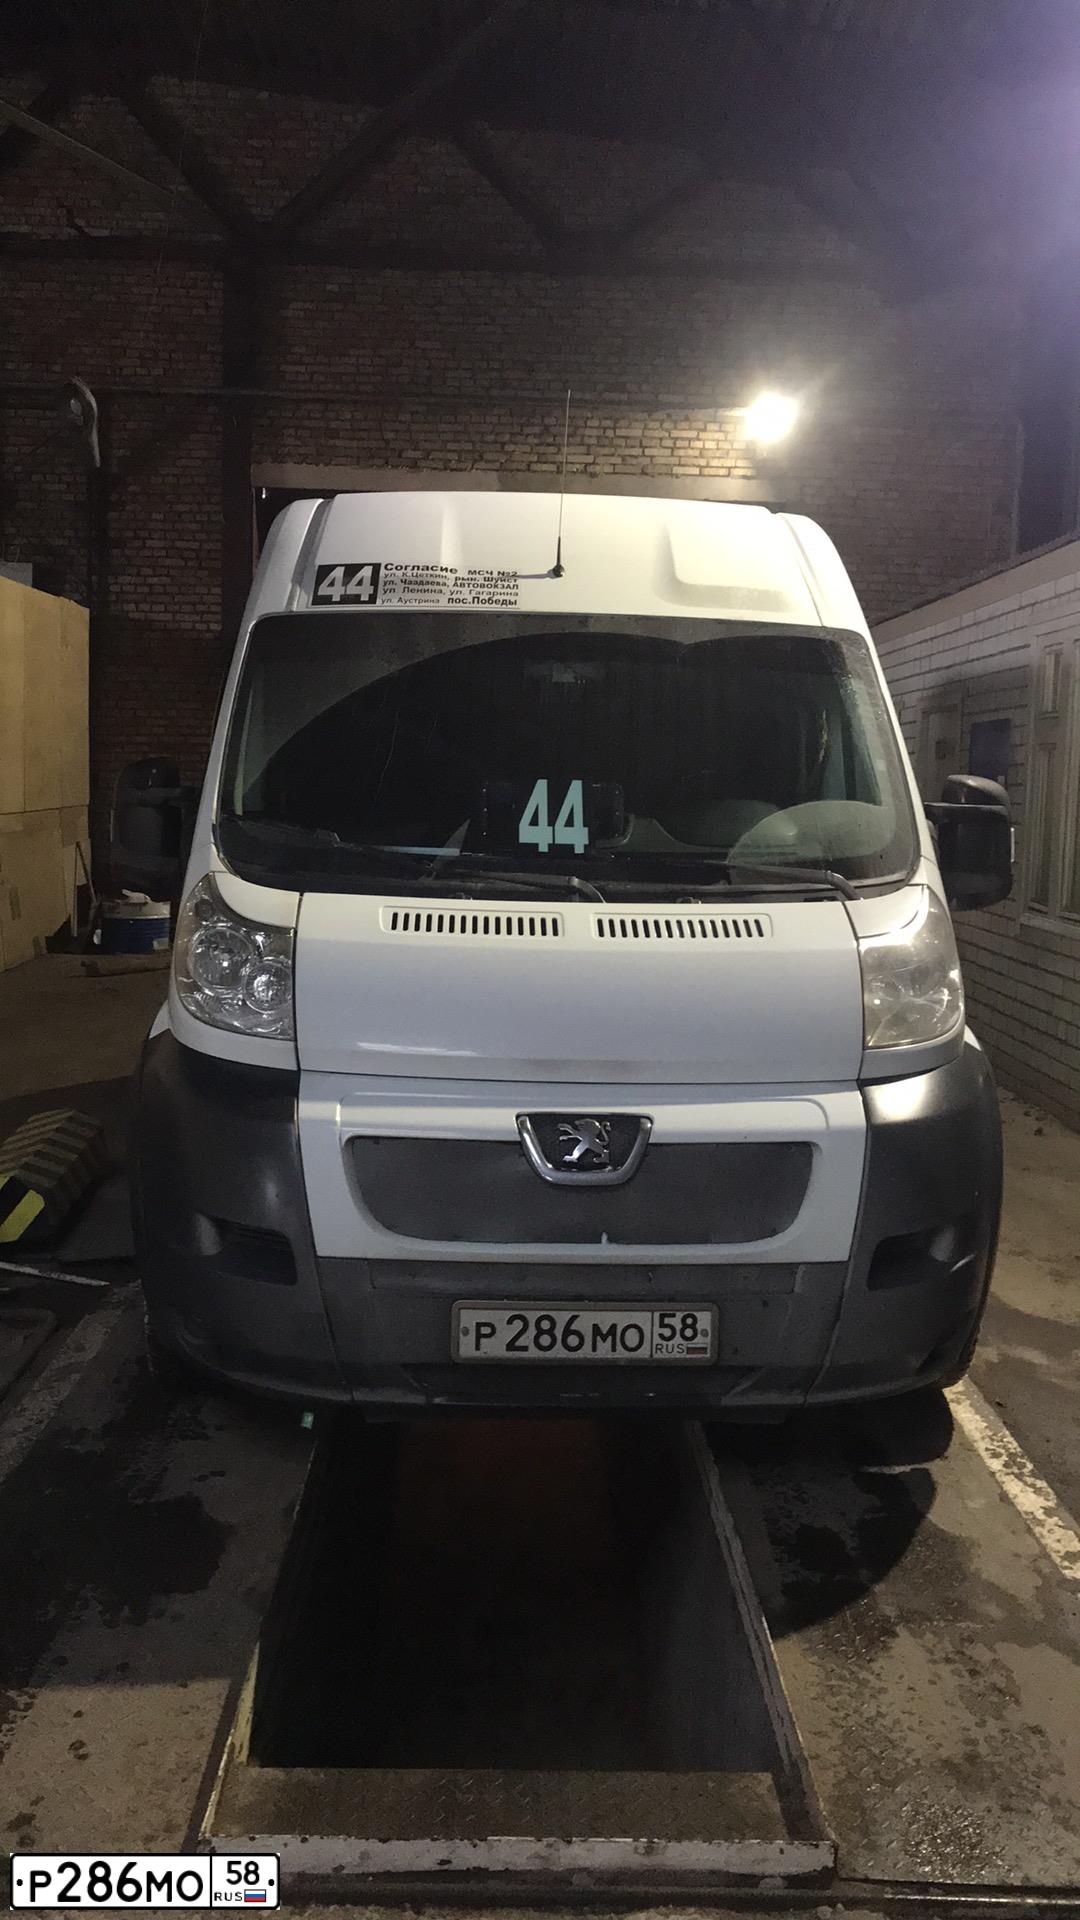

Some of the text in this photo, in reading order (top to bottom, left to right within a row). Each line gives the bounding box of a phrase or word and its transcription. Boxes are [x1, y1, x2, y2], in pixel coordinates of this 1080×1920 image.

[384, 563, 458, 575] Согласие
[317, 565, 375, 602] 44
[452, 582, 519, 590] АВТОВОКЗАЛ
[402, 586, 446, 595] Ленина,
[469, 588, 519, 598] Гагарина
[397, 597, 440, 605] Аустрина
[447, 596, 517, 607] пос.Победы
[518, 779, 589, 854] 44
[657, 1312, 699, 1342] 58
[654, 1344, 685, 1355] RUS
